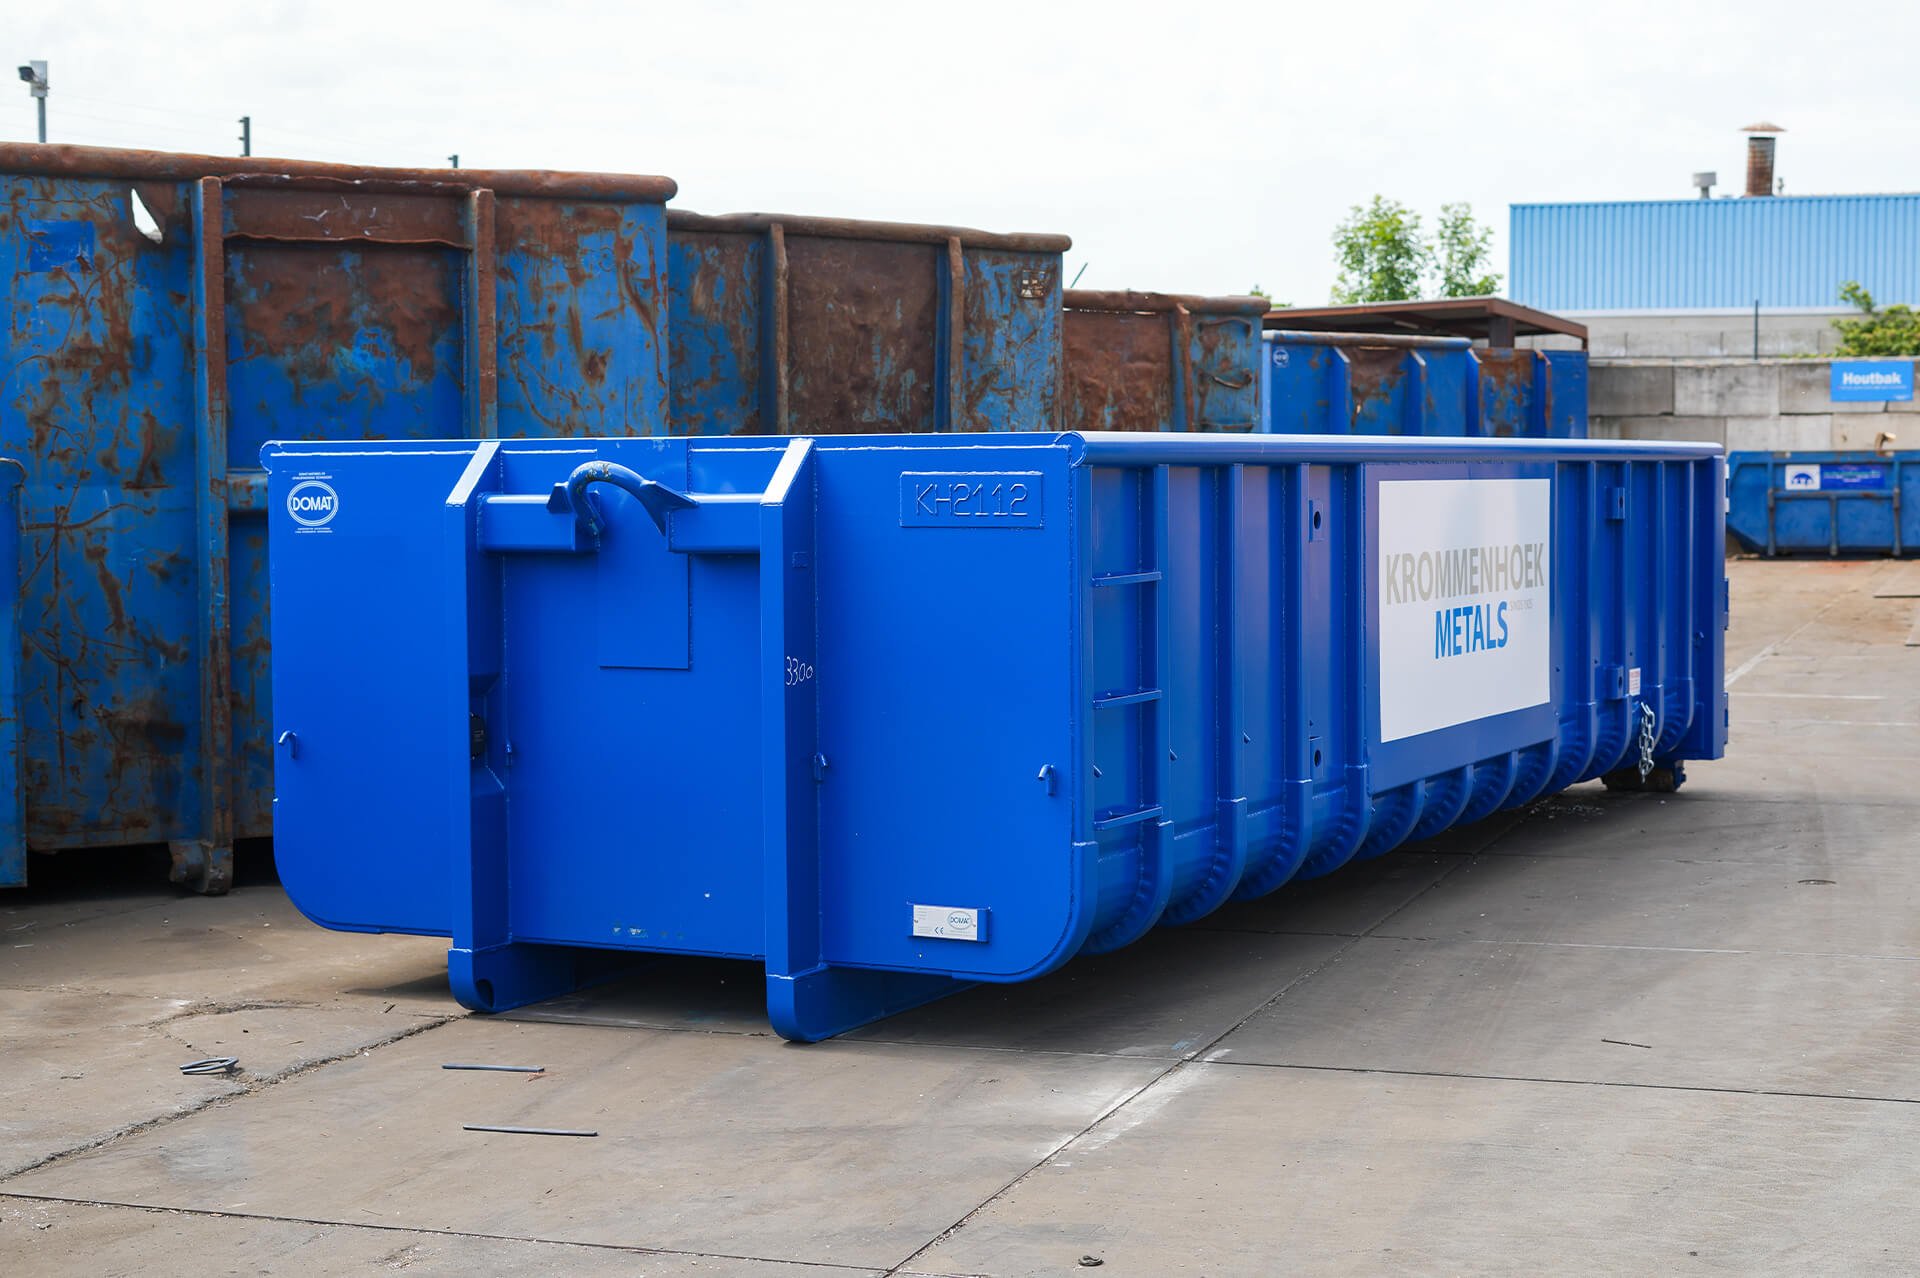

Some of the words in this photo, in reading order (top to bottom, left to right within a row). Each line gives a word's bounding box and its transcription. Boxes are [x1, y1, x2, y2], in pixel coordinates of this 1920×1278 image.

[1843, 372, 1902, 385] Houtbak
[292, 496, 333, 511] DOMAT
[915, 483, 1028, 516] KH2112
[1386, 543, 1544, 605] KROMMENHOEK
[1435, 601, 1508, 659] METALS
[786, 656, 813, 685] 3300
